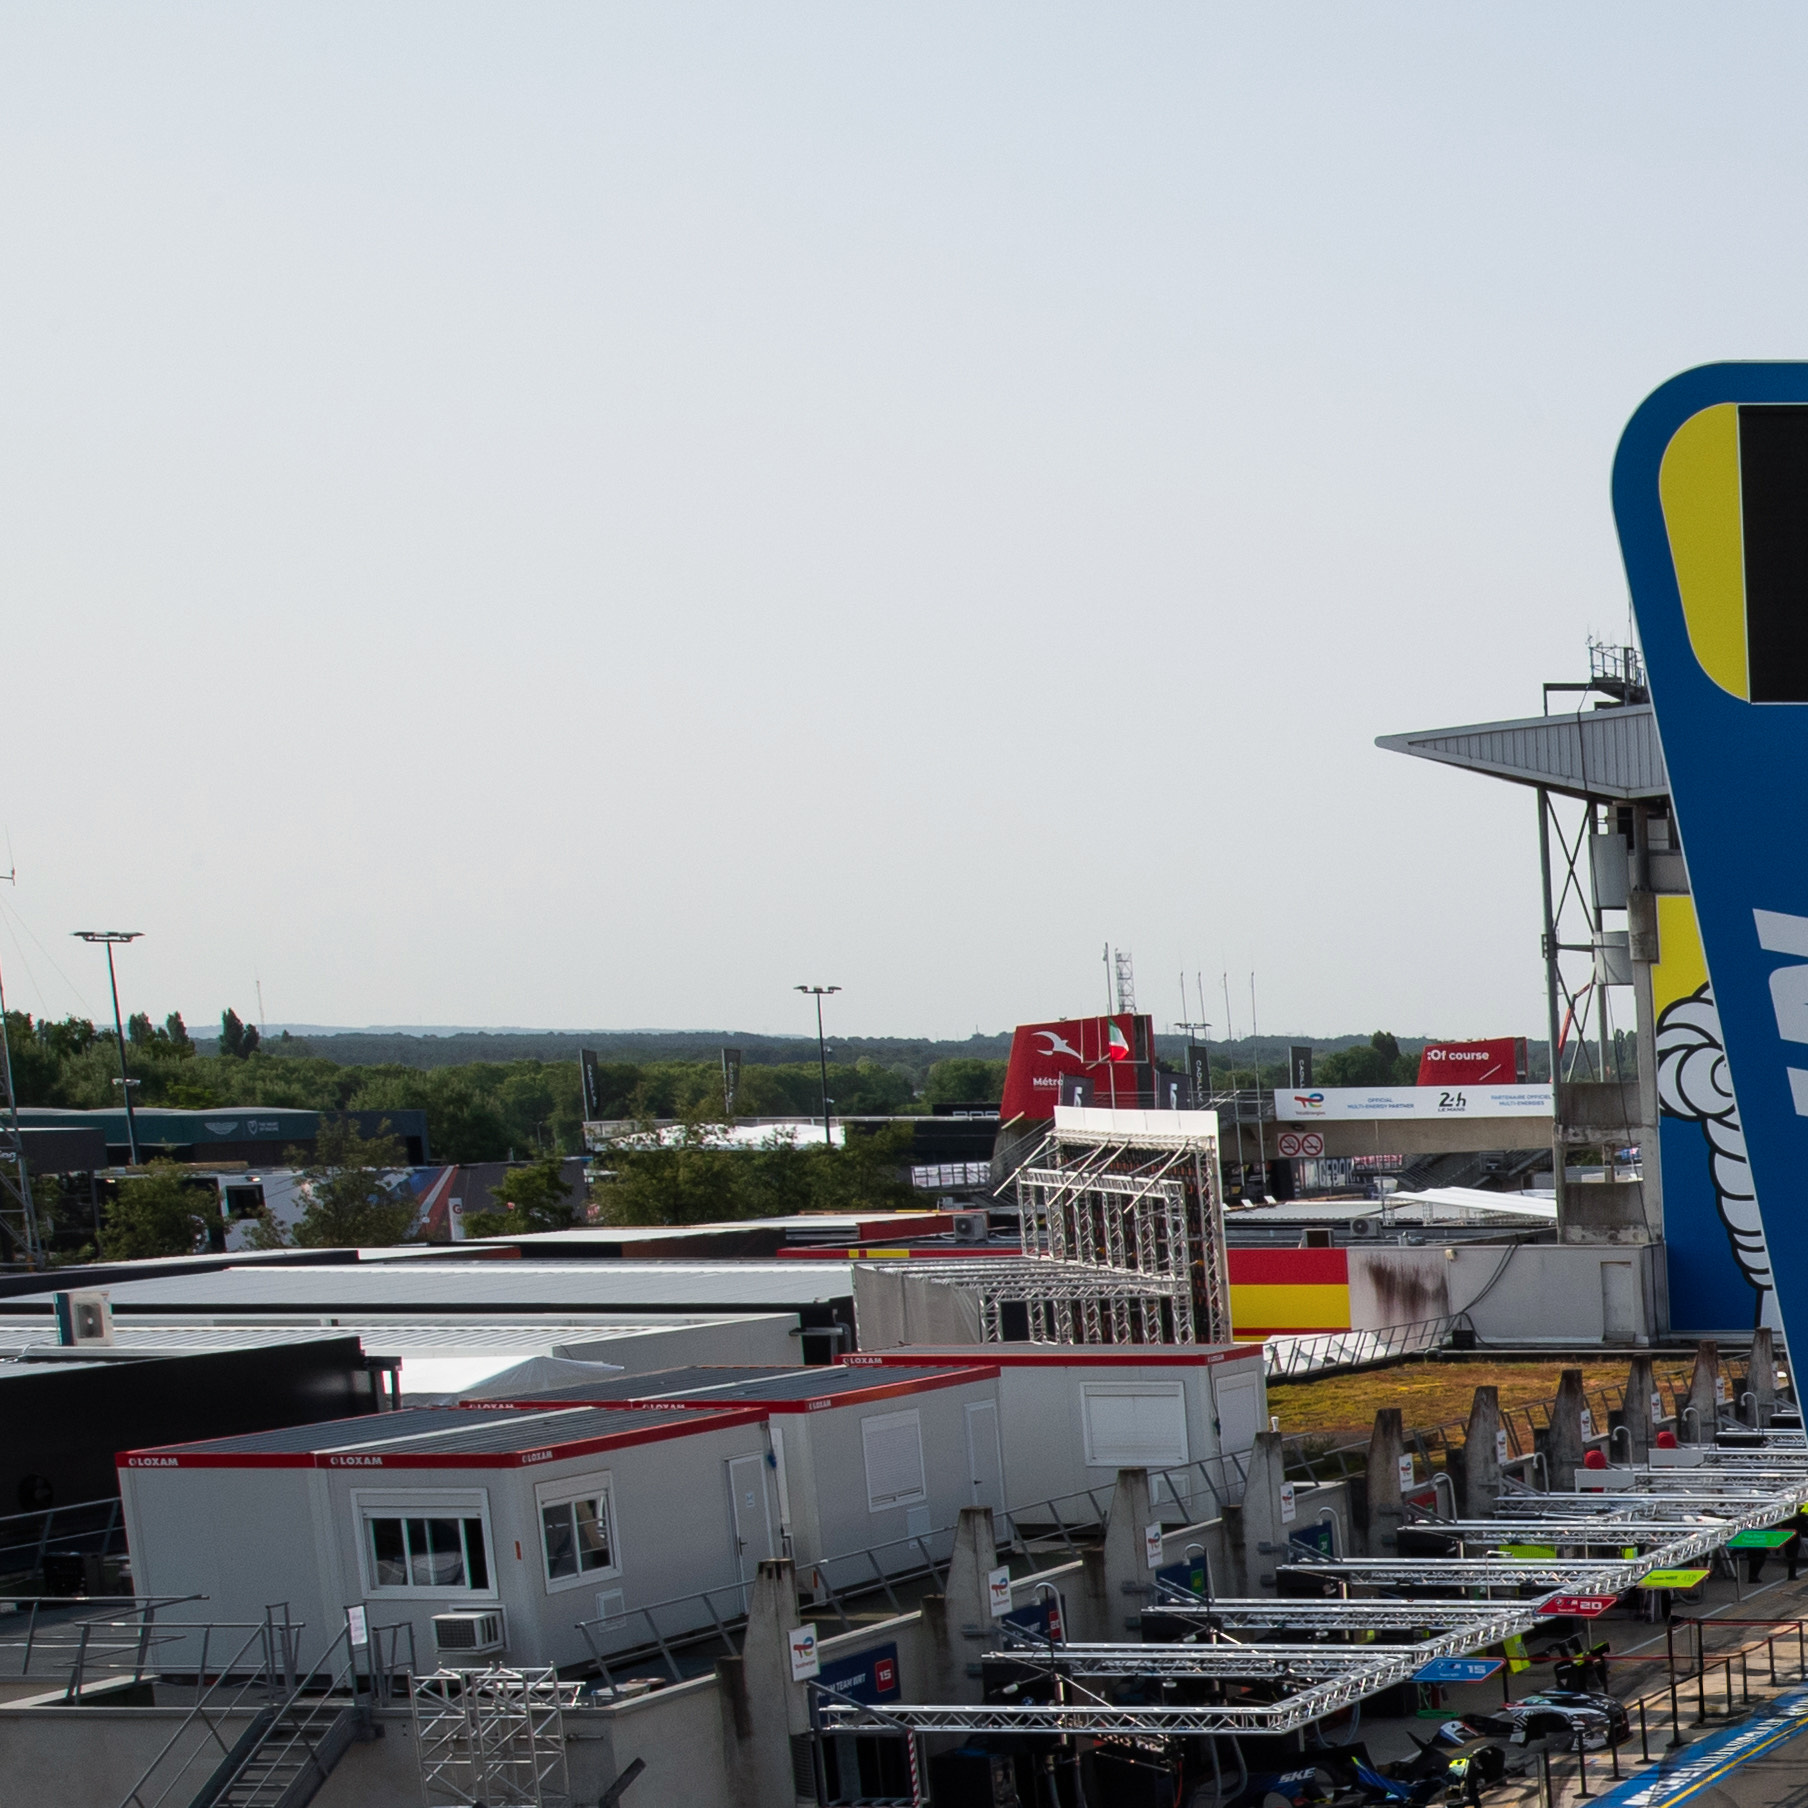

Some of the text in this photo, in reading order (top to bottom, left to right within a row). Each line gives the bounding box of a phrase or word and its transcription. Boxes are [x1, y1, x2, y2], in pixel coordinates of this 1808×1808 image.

[1449, 1050, 1489, 1060] course
[340, 1457, 382, 1465] LOXAM
[527, 1450, 553, 1463] LOXAM
[137, 1458, 178, 1466] LOXAM
[1580, 1601, 1602, 1610] 20
[1468, 1665, 1486, 1674] 15
[880, 1669, 891, 1681] 15
